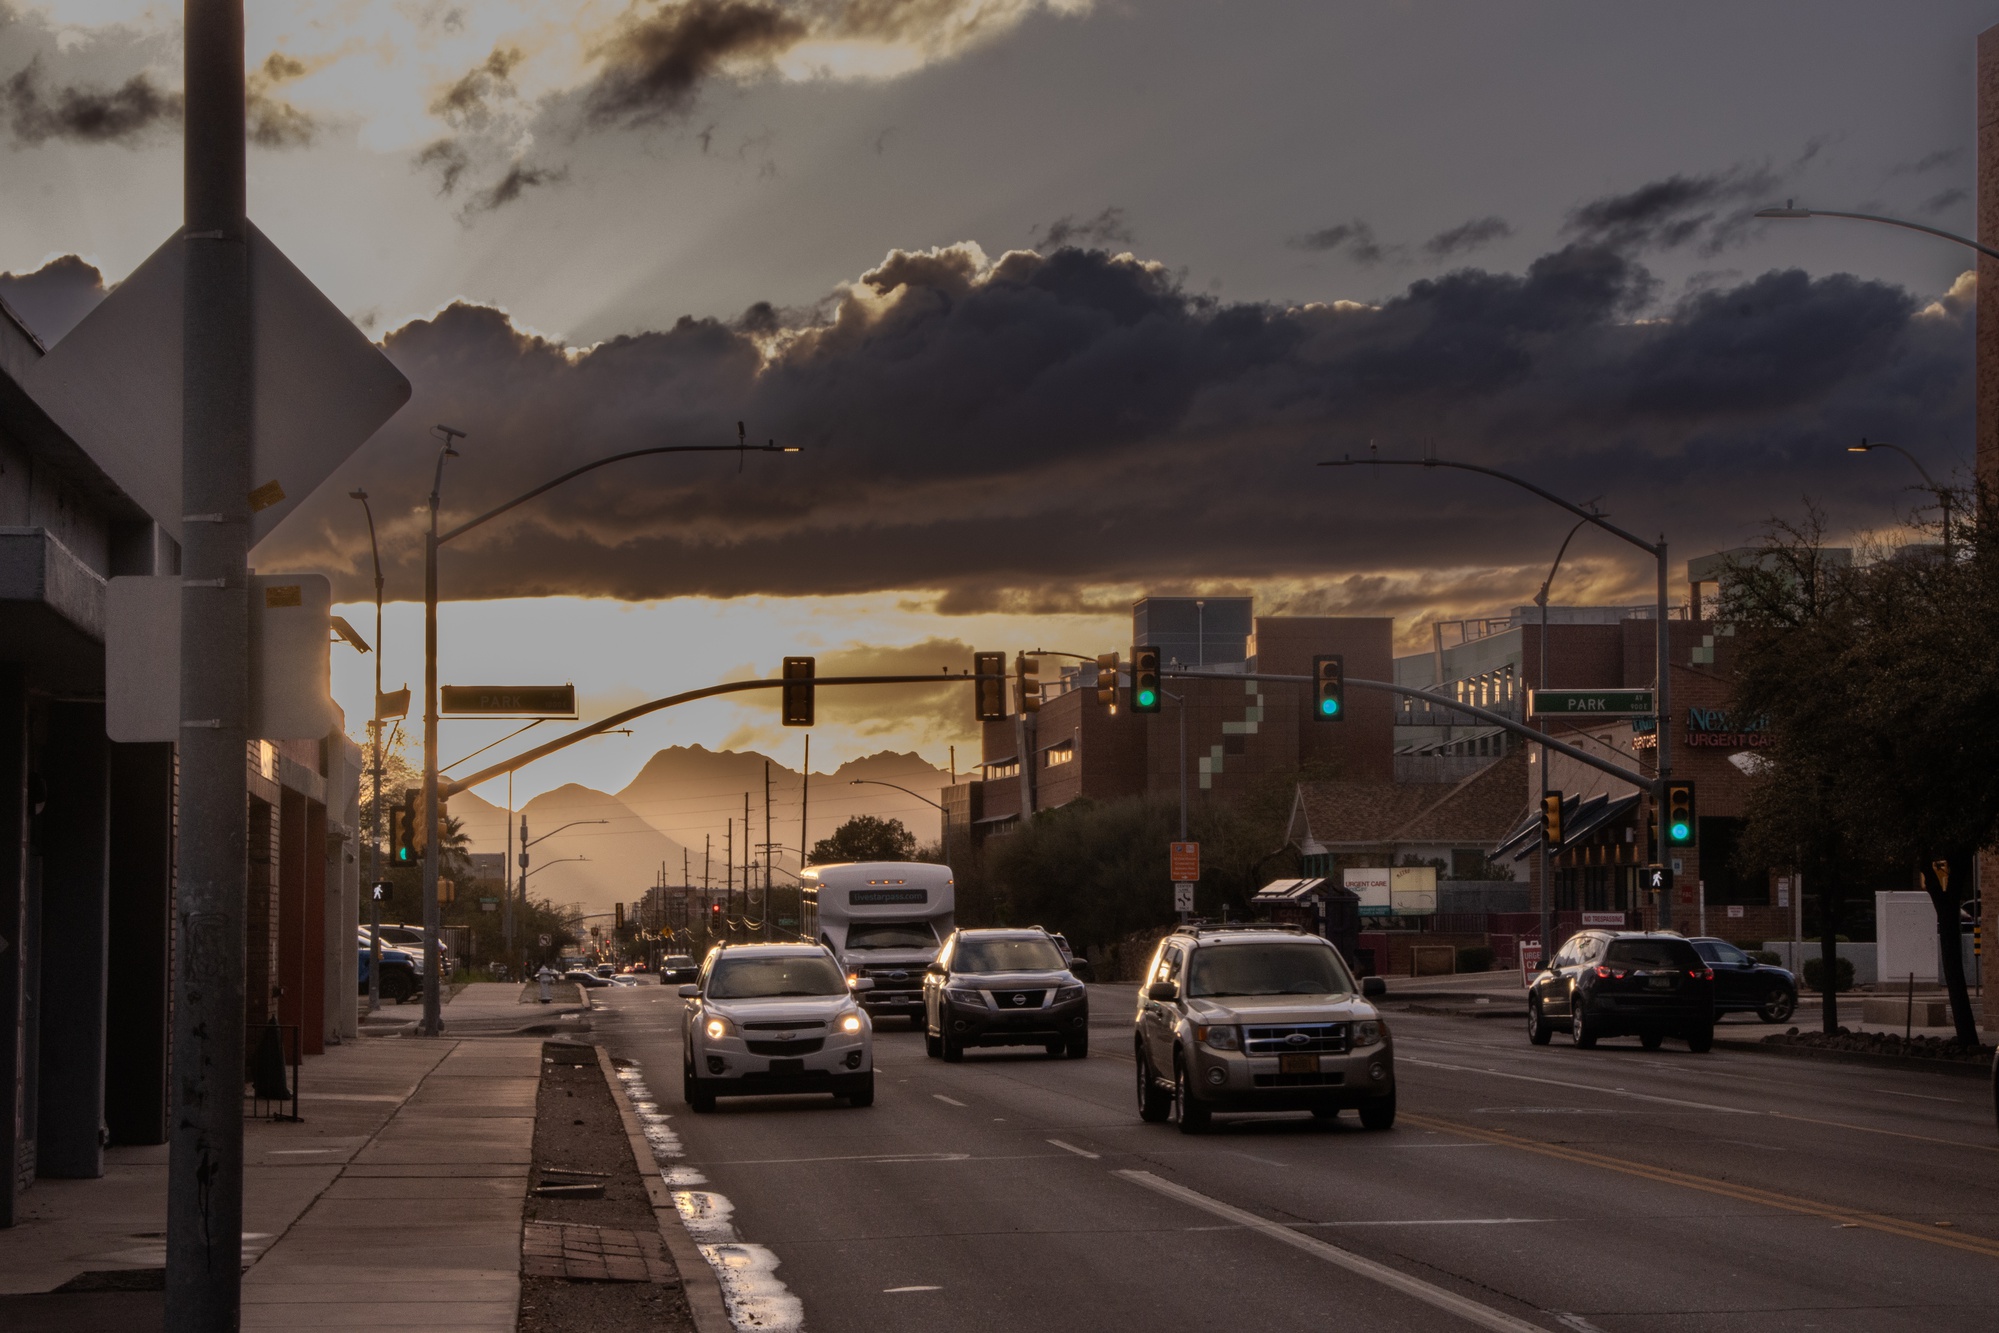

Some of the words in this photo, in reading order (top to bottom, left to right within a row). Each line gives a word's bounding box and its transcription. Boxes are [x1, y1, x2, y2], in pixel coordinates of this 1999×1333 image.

[480, 695, 521, 708] PARK
[1568, 699, 1605, 710] PARK
[1690, 733, 1746, 747] URGENT
[1748, 733, 1777, 747] CAR
[1593, 915, 1623, 923] TRESPASSING
[1524, 951, 1541, 960] URGE
